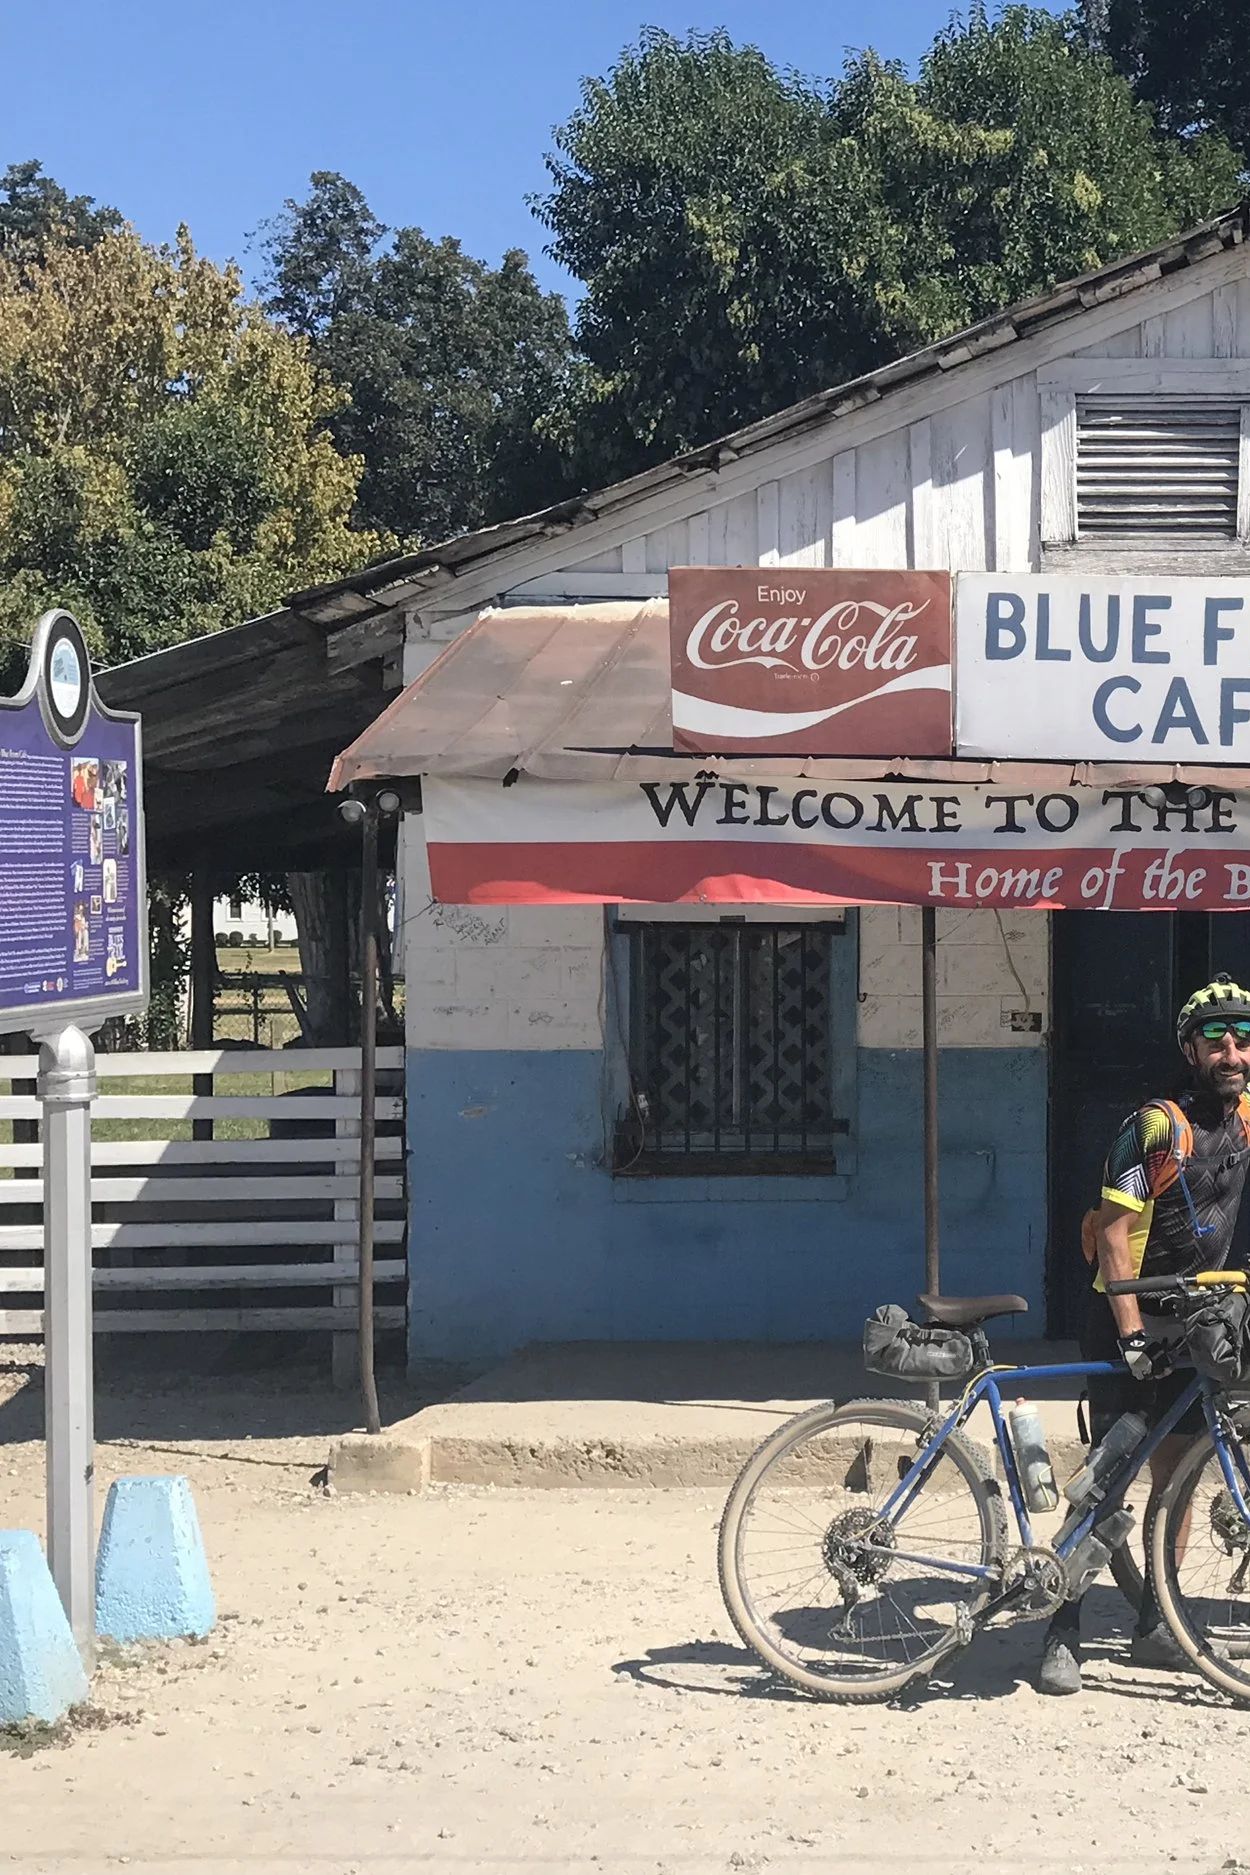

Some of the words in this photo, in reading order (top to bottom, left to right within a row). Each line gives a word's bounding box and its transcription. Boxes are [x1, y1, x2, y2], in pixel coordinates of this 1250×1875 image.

[757, 586, 806, 605] Enjoy
[686, 598, 931, 672] Coca-Cola
[985, 591, 1172, 664] BLUE
[640, 782, 961, 834] WELCOME
[985, 792, 1080, 834] TO
[1102, 790, 1237, 833] THE
[926, 860, 1060, 898] Home
[1081, 847, 1132, 910] of
[1143, 847, 1207, 900] the
